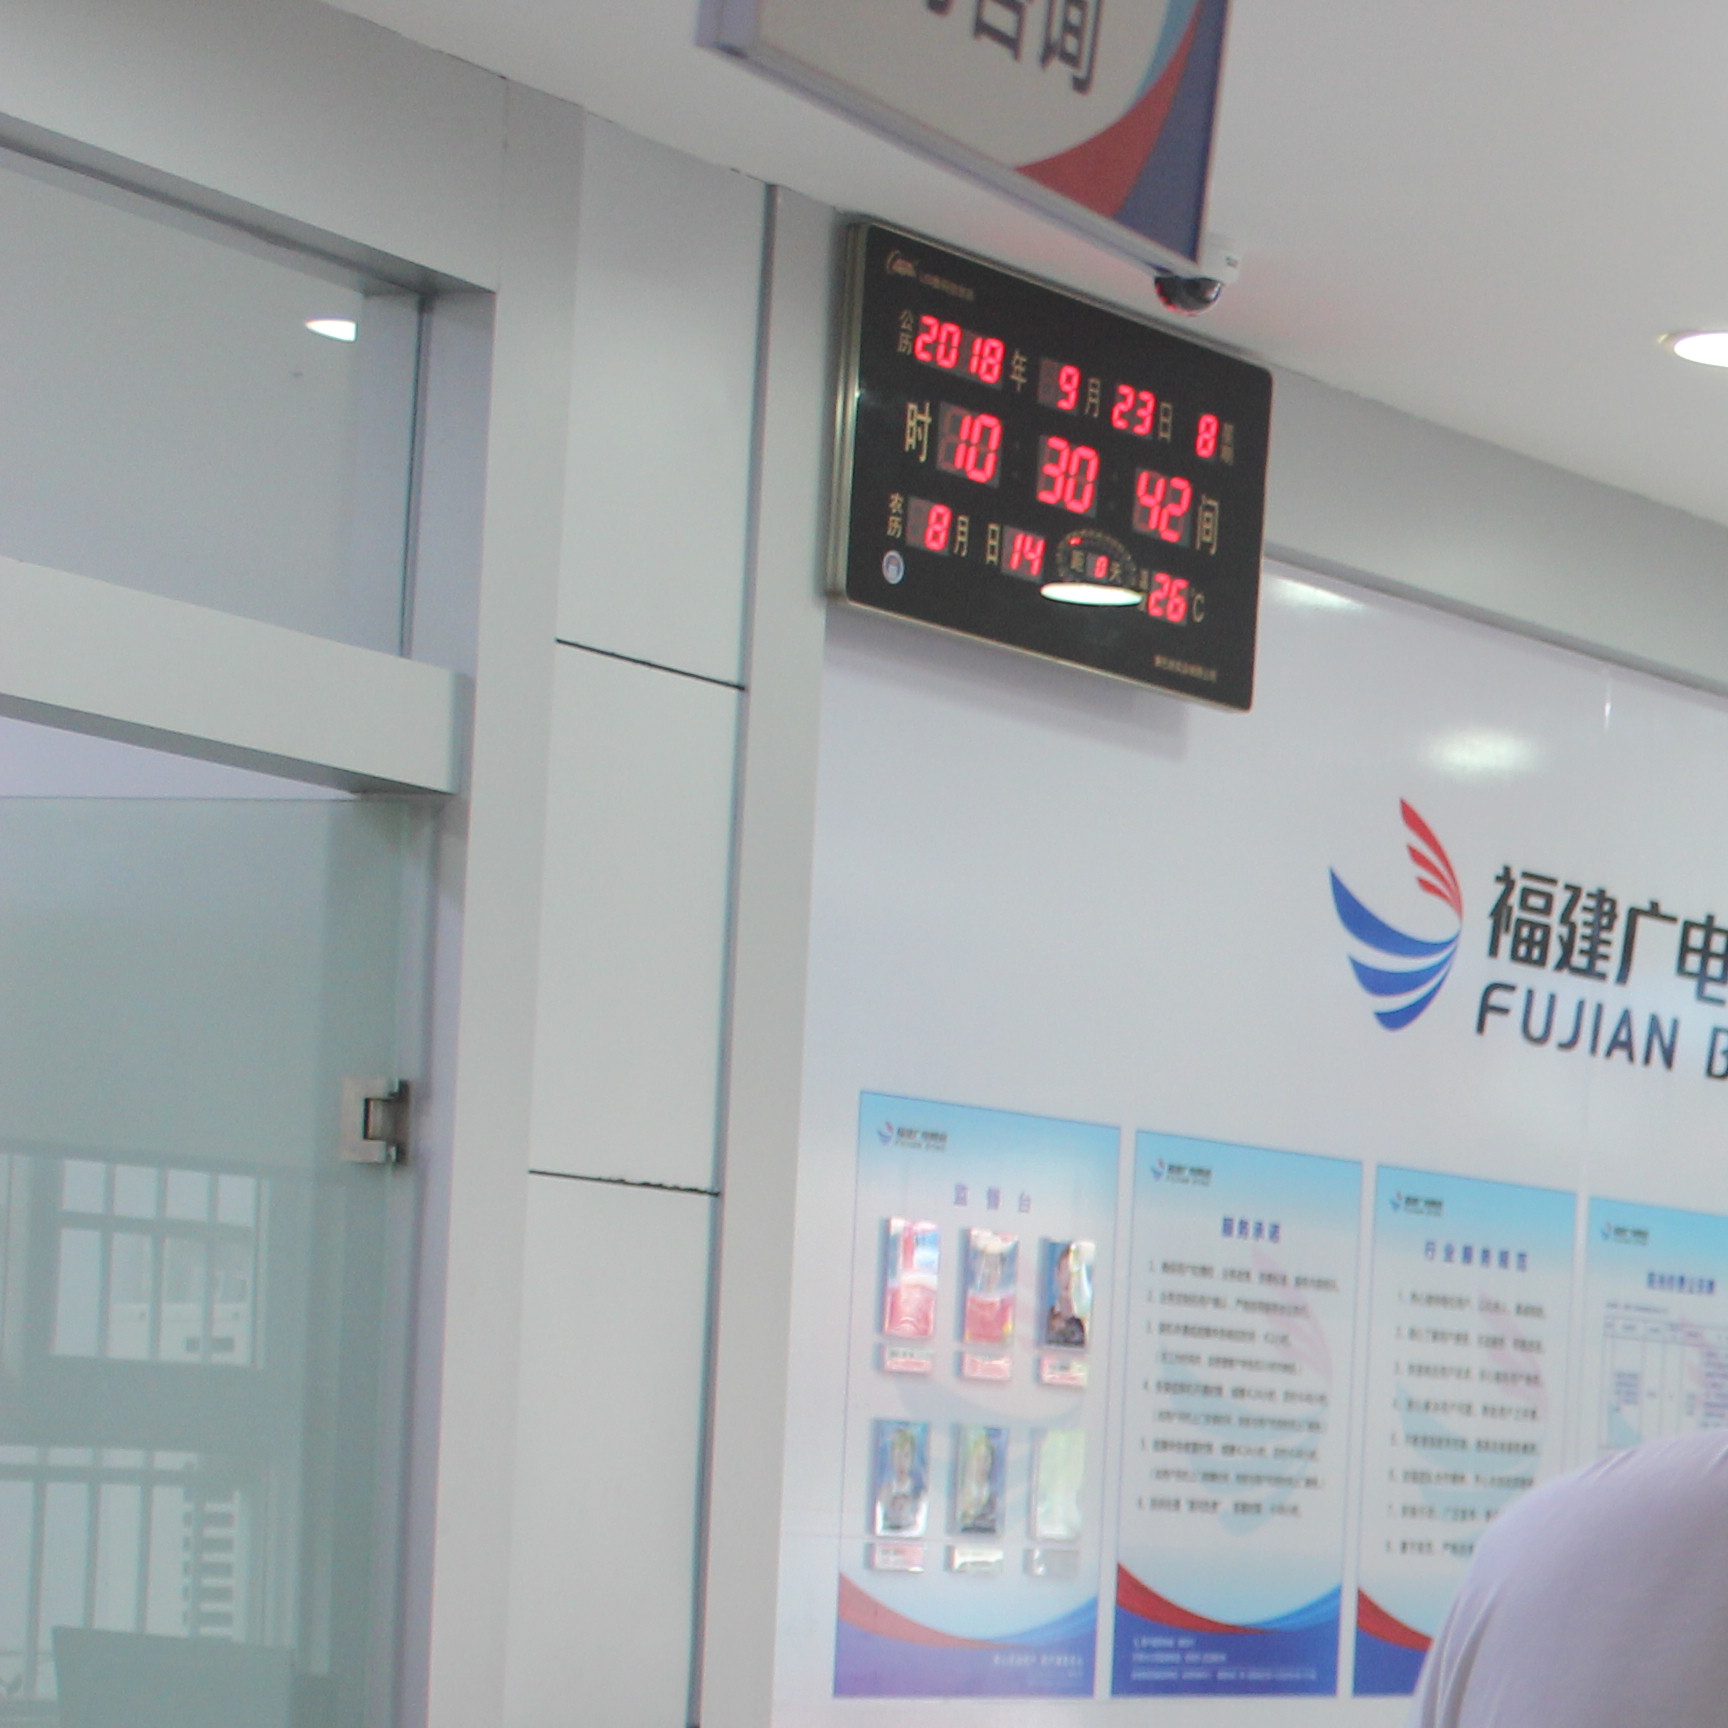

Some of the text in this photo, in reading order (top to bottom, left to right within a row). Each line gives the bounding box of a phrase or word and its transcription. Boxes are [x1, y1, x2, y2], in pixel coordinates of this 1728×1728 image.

[914, 316, 1005, 384] 2018
[1058, 365, 1081, 411] 9
[1111, 385, 1156, 436] 23
[954, 413, 1001, 483] 10
[1037, 436, 1099, 513] 30
[1136, 470, 1192, 543] 42
[1009, 532, 1046, 577] 14
[1148, 572, 1190, 623] 26
[1475, 981, 1679, 1072] FUJIAN
